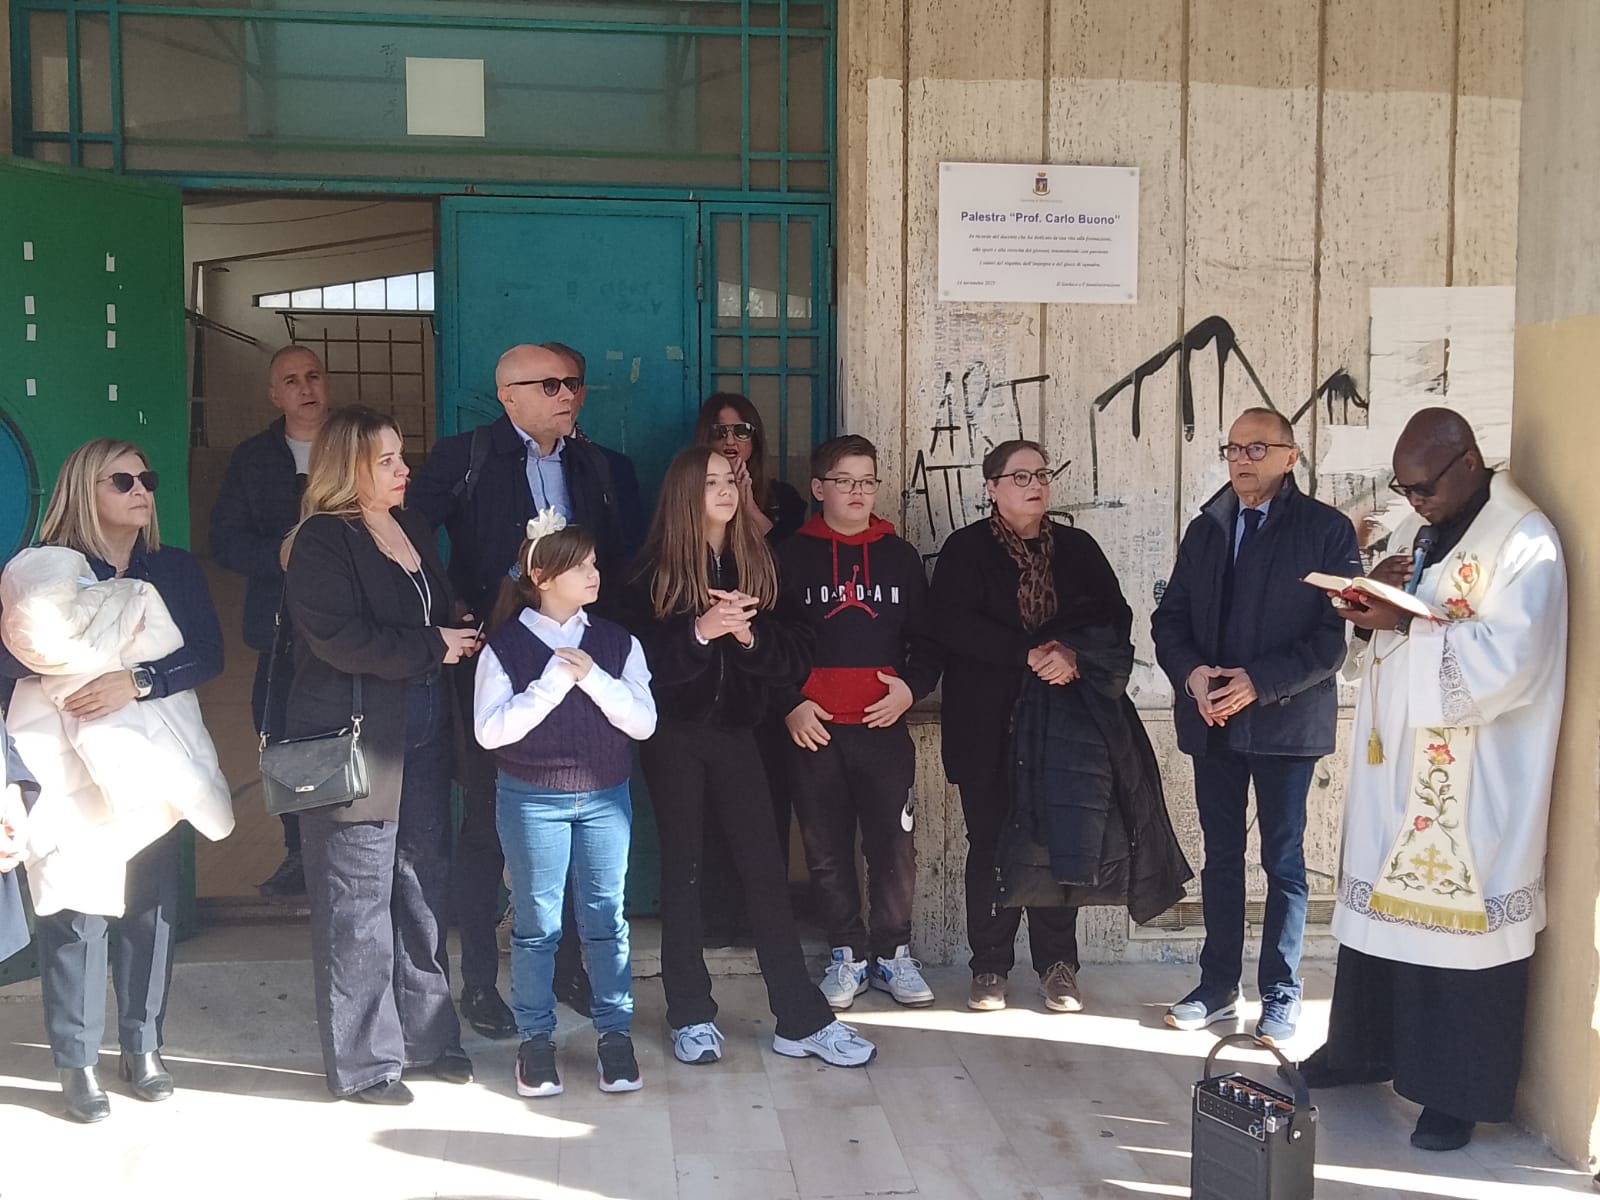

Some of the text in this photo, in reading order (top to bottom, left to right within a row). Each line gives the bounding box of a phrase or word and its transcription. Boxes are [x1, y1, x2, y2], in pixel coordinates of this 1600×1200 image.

[960, 210, 1120, 225] Palestra "Prof. Carlo Buono"
[805, 584, 899, 605] JORDAN
